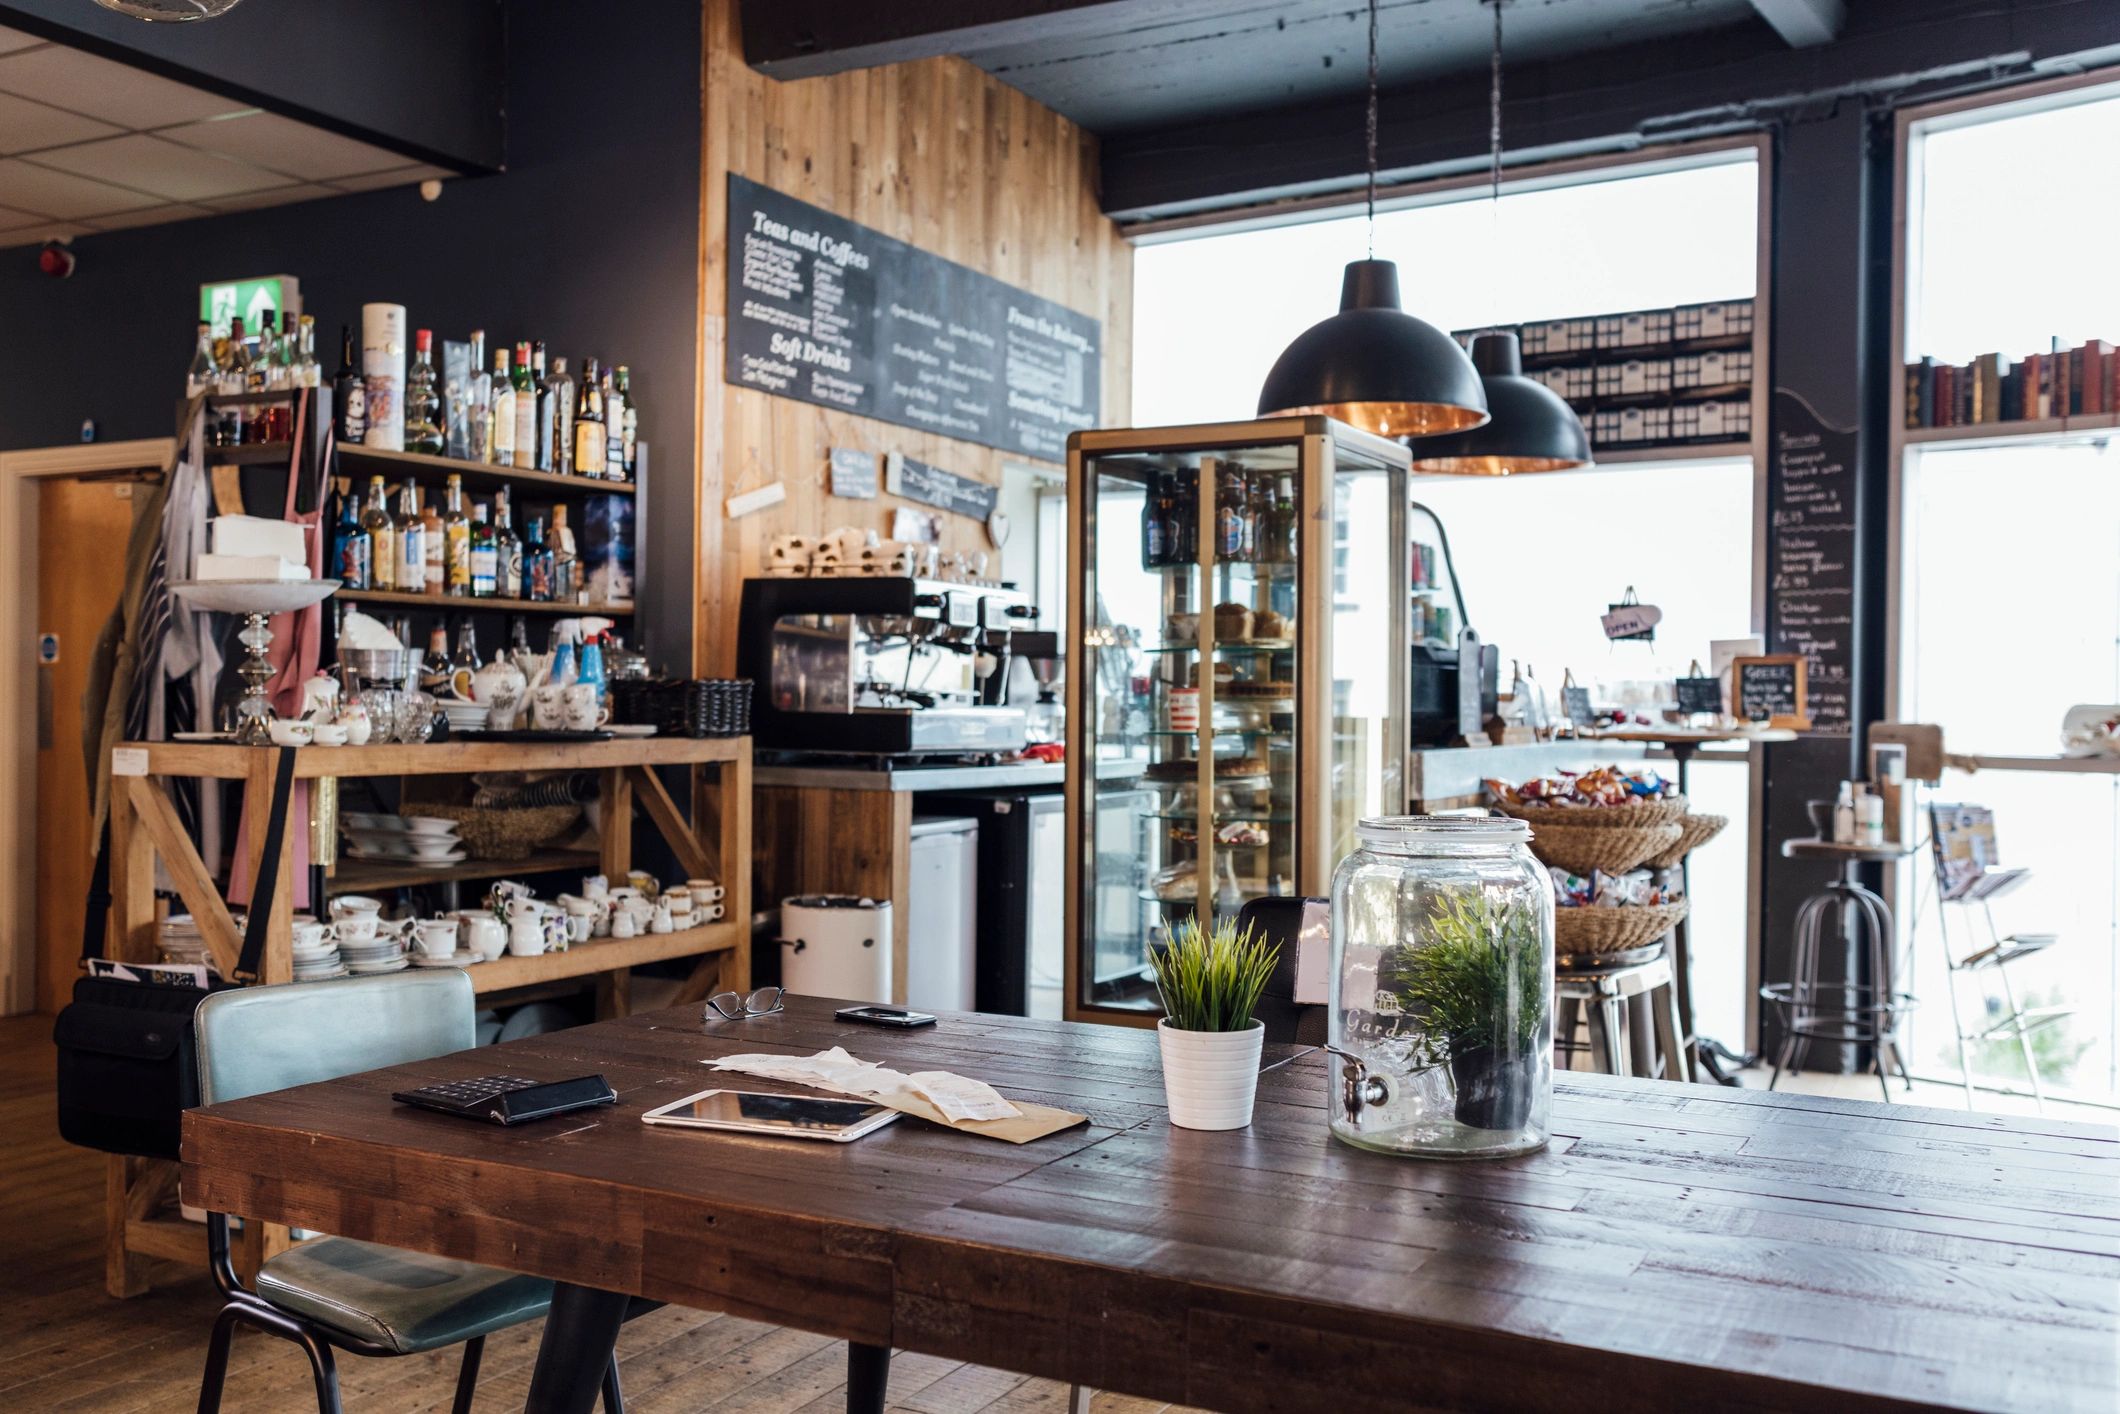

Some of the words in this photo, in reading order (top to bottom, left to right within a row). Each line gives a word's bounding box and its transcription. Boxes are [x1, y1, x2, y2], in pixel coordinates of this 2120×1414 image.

[752, 210, 789, 242] Teas
[789, 229, 820, 252] and
[820, 236, 869, 270] Coffees
[769, 332, 801, 361] Soft
[802, 341, 851, 373] Drinks
[1606, 620, 1638, 637] OPEN
